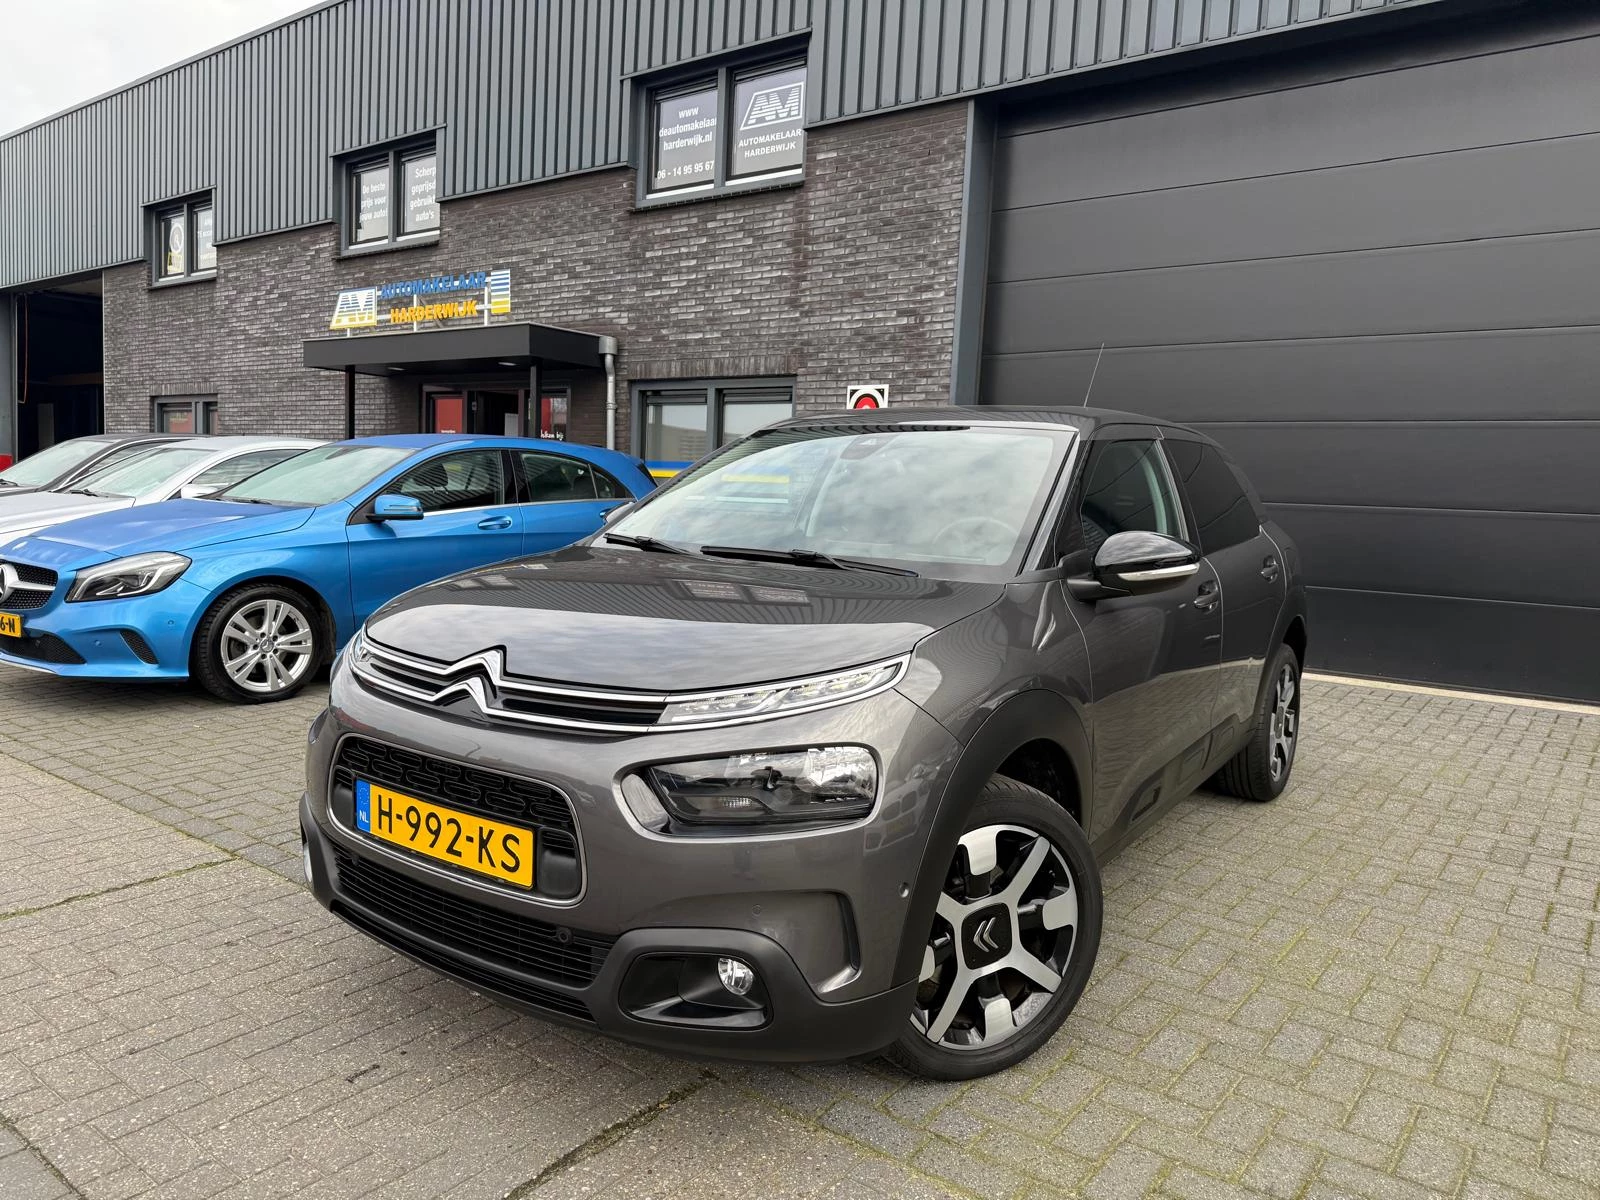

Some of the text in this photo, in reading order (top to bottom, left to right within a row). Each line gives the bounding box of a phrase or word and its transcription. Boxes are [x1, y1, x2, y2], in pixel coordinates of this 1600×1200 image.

[678, 107, 699, 119] www
[663, 132, 713, 151] harderwijk.nl
[738, 128, 802, 148] AUTOMAKELAAR
[744, 142, 796, 159] HARDERWIJK
[657, 170, 666, 180] 06
[673, 166, 682, 177] 14
[683, 164, 693, 175] 95
[694, 162, 704, 173] 95
[705, 160, 715, 171] 67
[379, 271, 486, 300] AUTOMAKELAAR
[390, 300, 478, 324] HARDERWIJK
[359, 810, 369, 823] NL
[378, 794, 521, 873] H-992-KS
